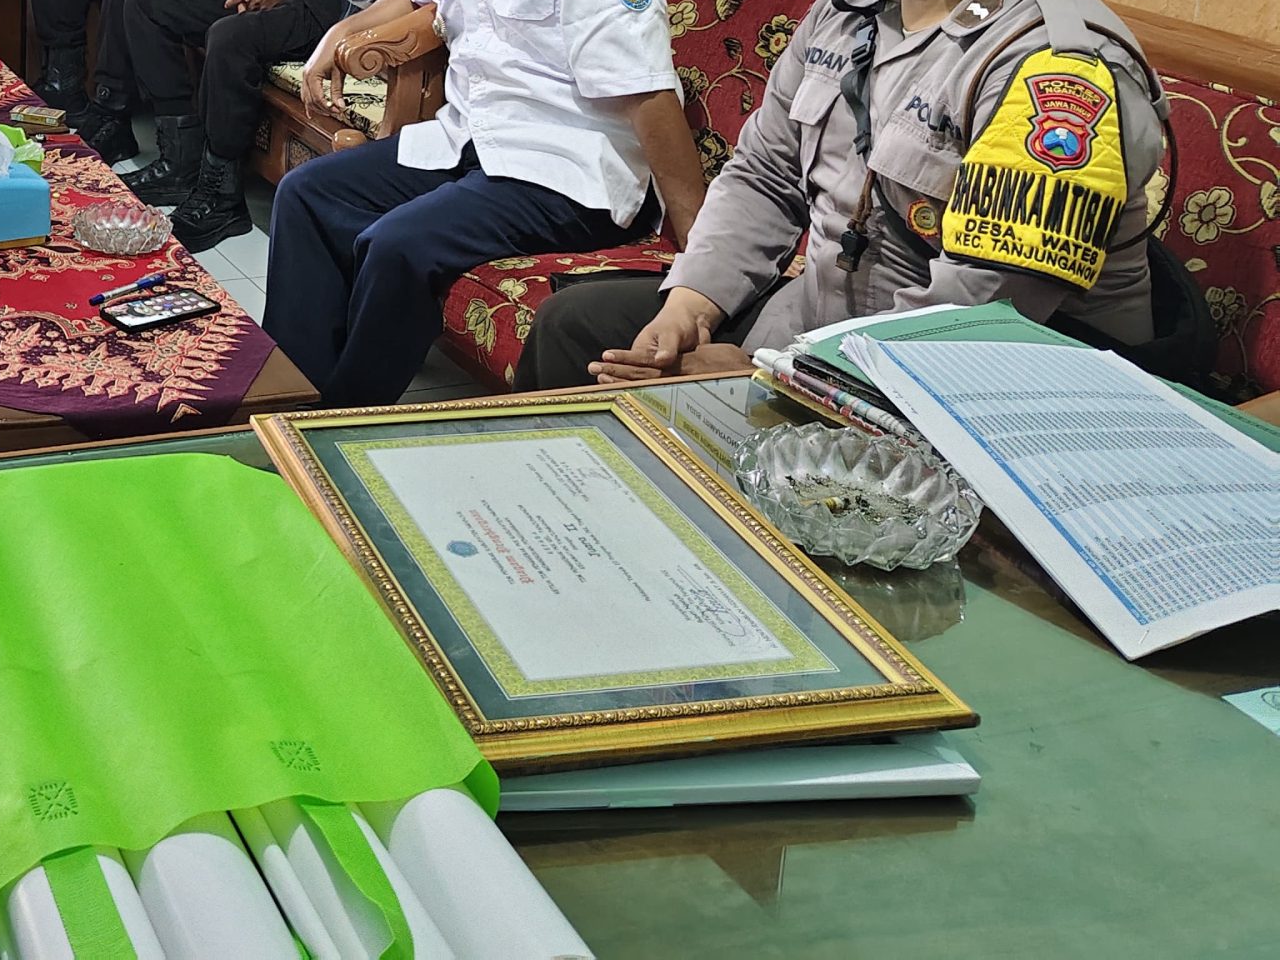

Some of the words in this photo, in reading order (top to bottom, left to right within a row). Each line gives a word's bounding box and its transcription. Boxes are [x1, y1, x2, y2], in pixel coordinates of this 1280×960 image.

[1039, 80, 1101, 103] POLRES
[1044, 100, 1069, 109] JAWA
[1070, 103, 1091, 119] TIMUR
[955, 231, 984, 249] KEC.
[1042, 233, 1099, 266] WATES
[573, 536, 602, 557] Juara
